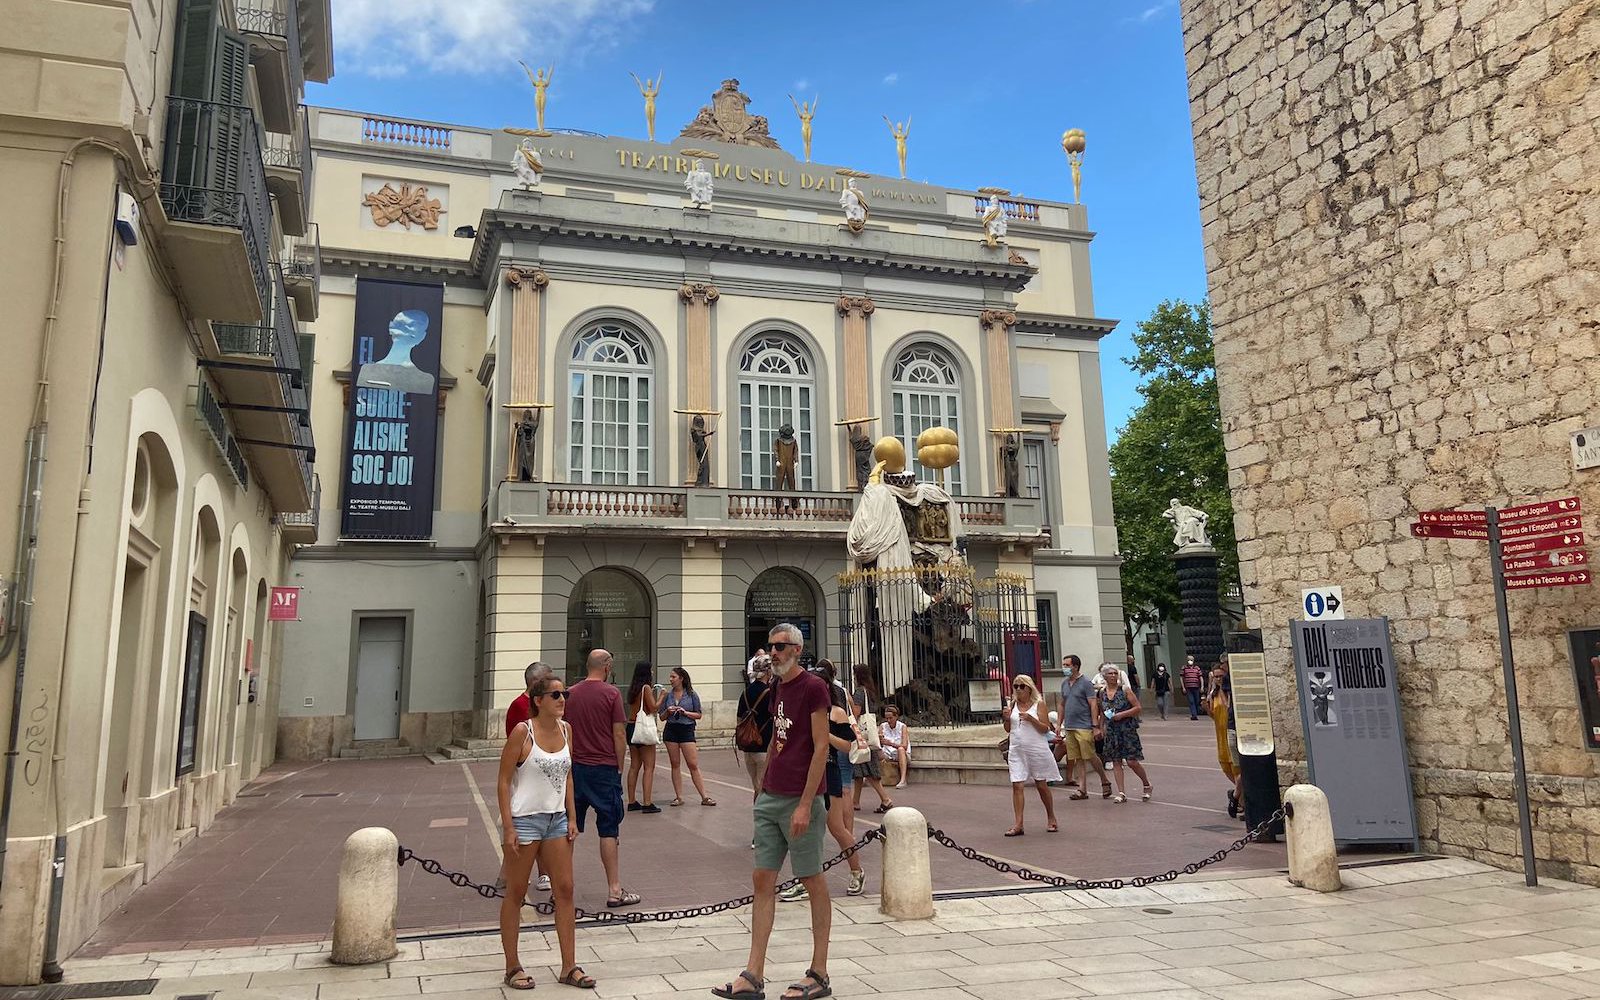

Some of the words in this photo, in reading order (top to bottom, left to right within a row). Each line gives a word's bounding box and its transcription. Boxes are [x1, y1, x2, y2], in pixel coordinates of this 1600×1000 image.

[714, 162, 791, 187] MUSEU
[359, 336, 375, 365] EL
[355, 387, 412, 419] SURRE-
[353, 421, 409, 452] ALISME
[351, 454, 385, 485] SOC
[387, 455, 414, 486] JO!
[1439, 513, 1456, 521] Castell
[1456, 513, 1463, 521] de
[1471, 513, 1486, 521] Ferran
[1499, 511, 1519, 520] Museu
[1519, 508, 1528, 517] del
[1529, 505, 1550, 517] Joguet
[1452, 528, 1467, 537] Torre
[1467, 529, 1488, 537] Galatea
[1501, 527, 1520, 536] Museu
[1520, 525, 1528, 534] de
[1503, 542, 1536, 553] Ajuntament
[1505, 562, 1514, 570] La
[1514, 559, 1535, 569] Rambla
[1507, 579, 1526, 587] Museu
[1527, 577, 1535, 585] de
[1535, 577, 1541, 585] la
[1302, 623, 1330, 668] DALÍ
[1332, 647, 1387, 689] FIGUERES
